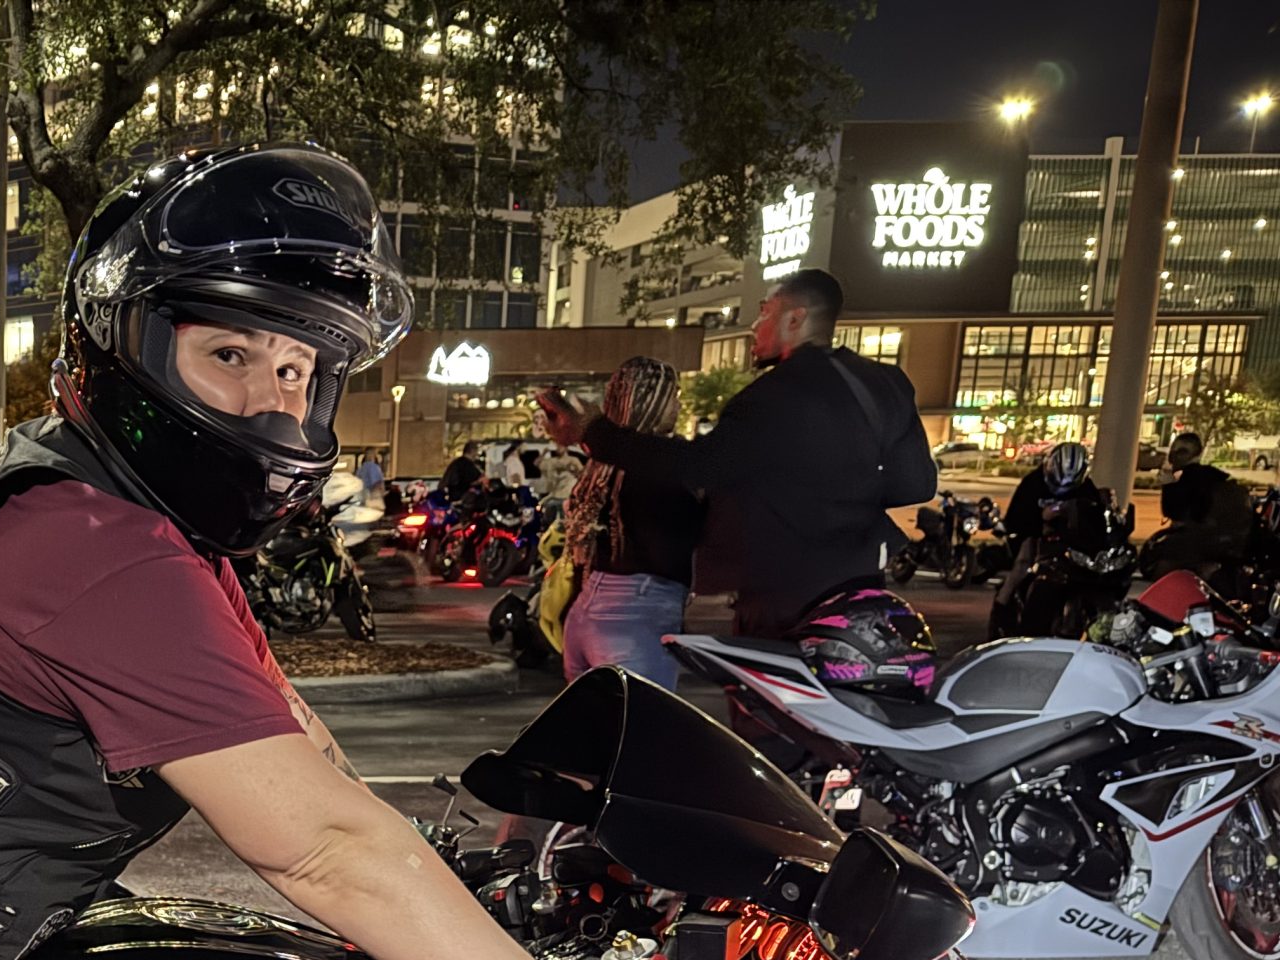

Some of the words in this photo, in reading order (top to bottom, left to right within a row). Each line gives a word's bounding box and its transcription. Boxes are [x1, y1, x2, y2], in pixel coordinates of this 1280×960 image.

[871, 182, 992, 215] WHOLE
[872, 215, 984, 247] FOODS
[881, 250, 966, 268] MARKET
[1059, 908, 1148, 949] SUZUKI
